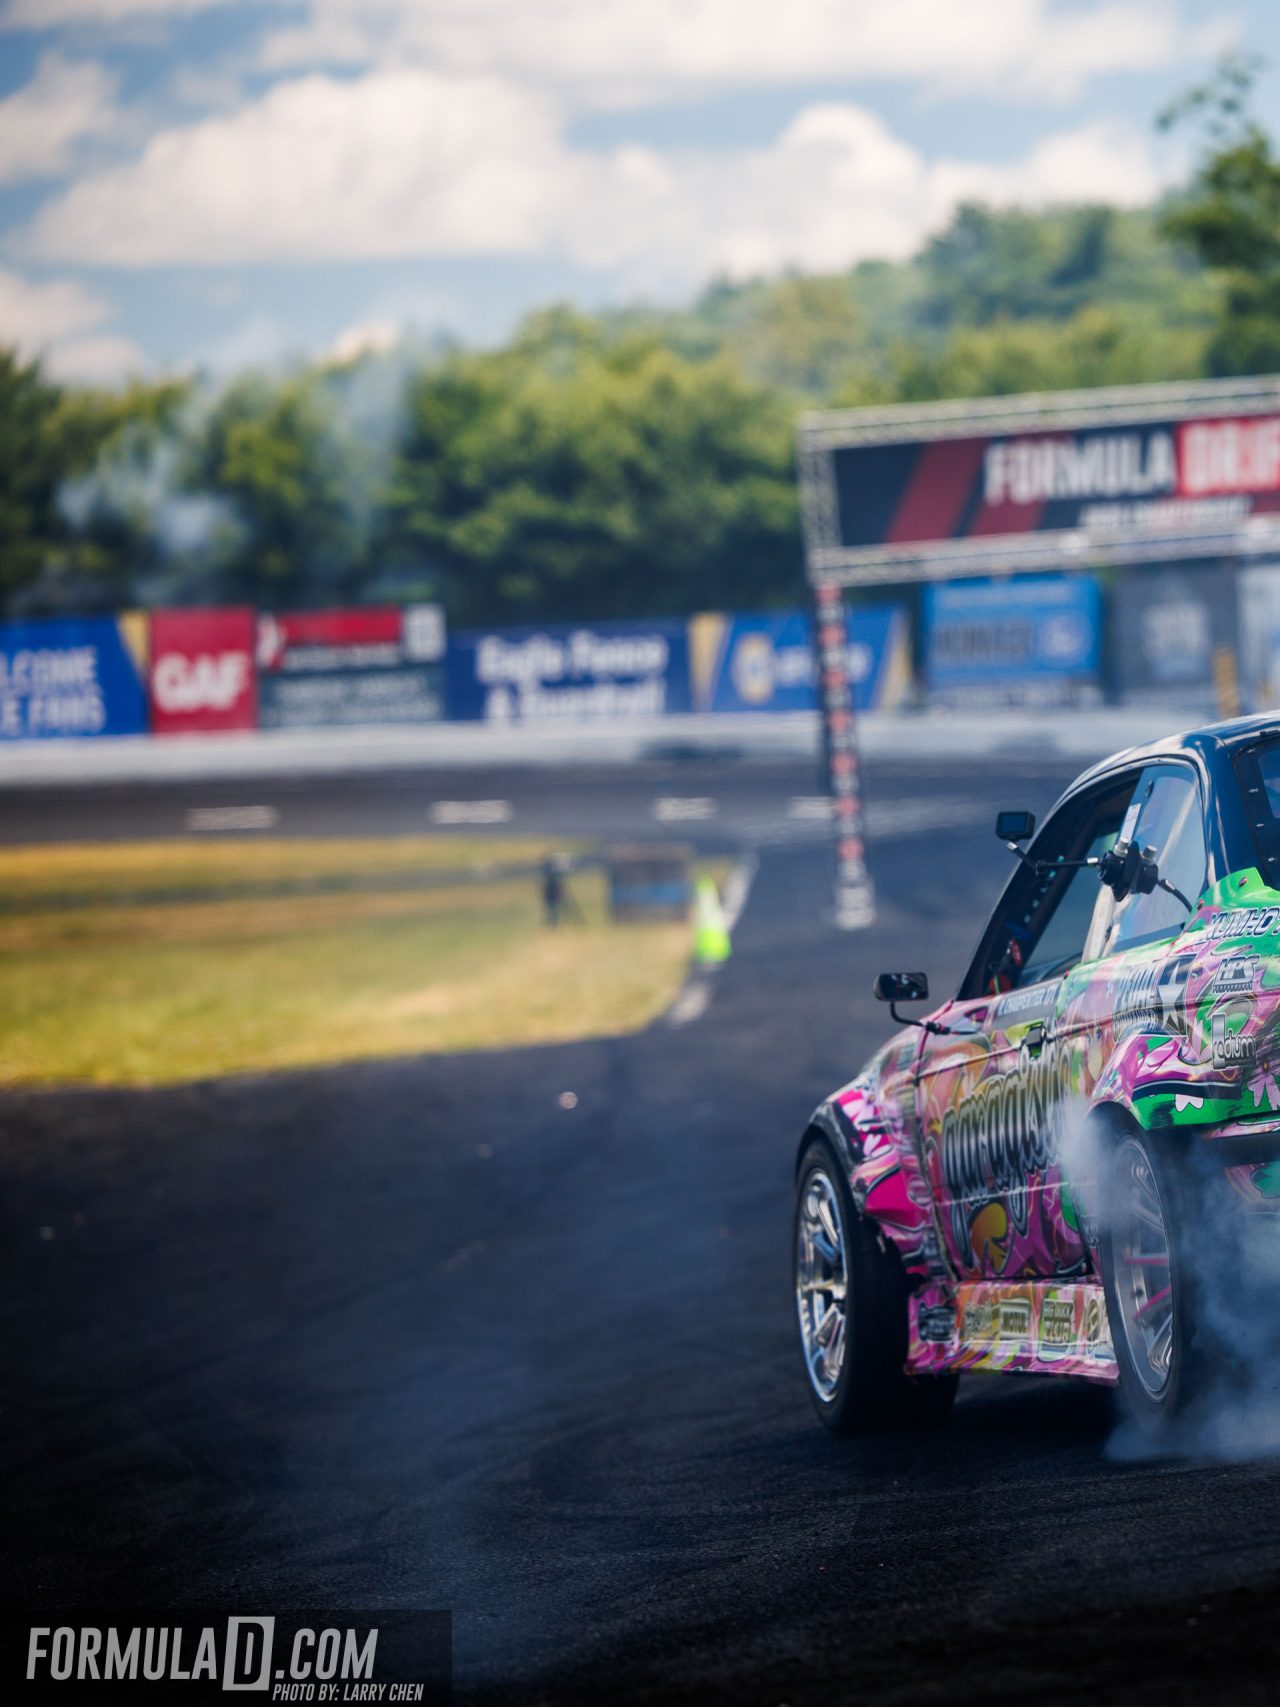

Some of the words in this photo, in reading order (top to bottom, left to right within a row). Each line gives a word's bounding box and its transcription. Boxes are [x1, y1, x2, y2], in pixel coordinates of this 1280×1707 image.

[983, 430, 1176, 507] FORMULA
[152, 650, 249, 713] GAF
[1201, 906, 1279, 943] KUMHO
[1215, 955, 1260, 980] HPS
